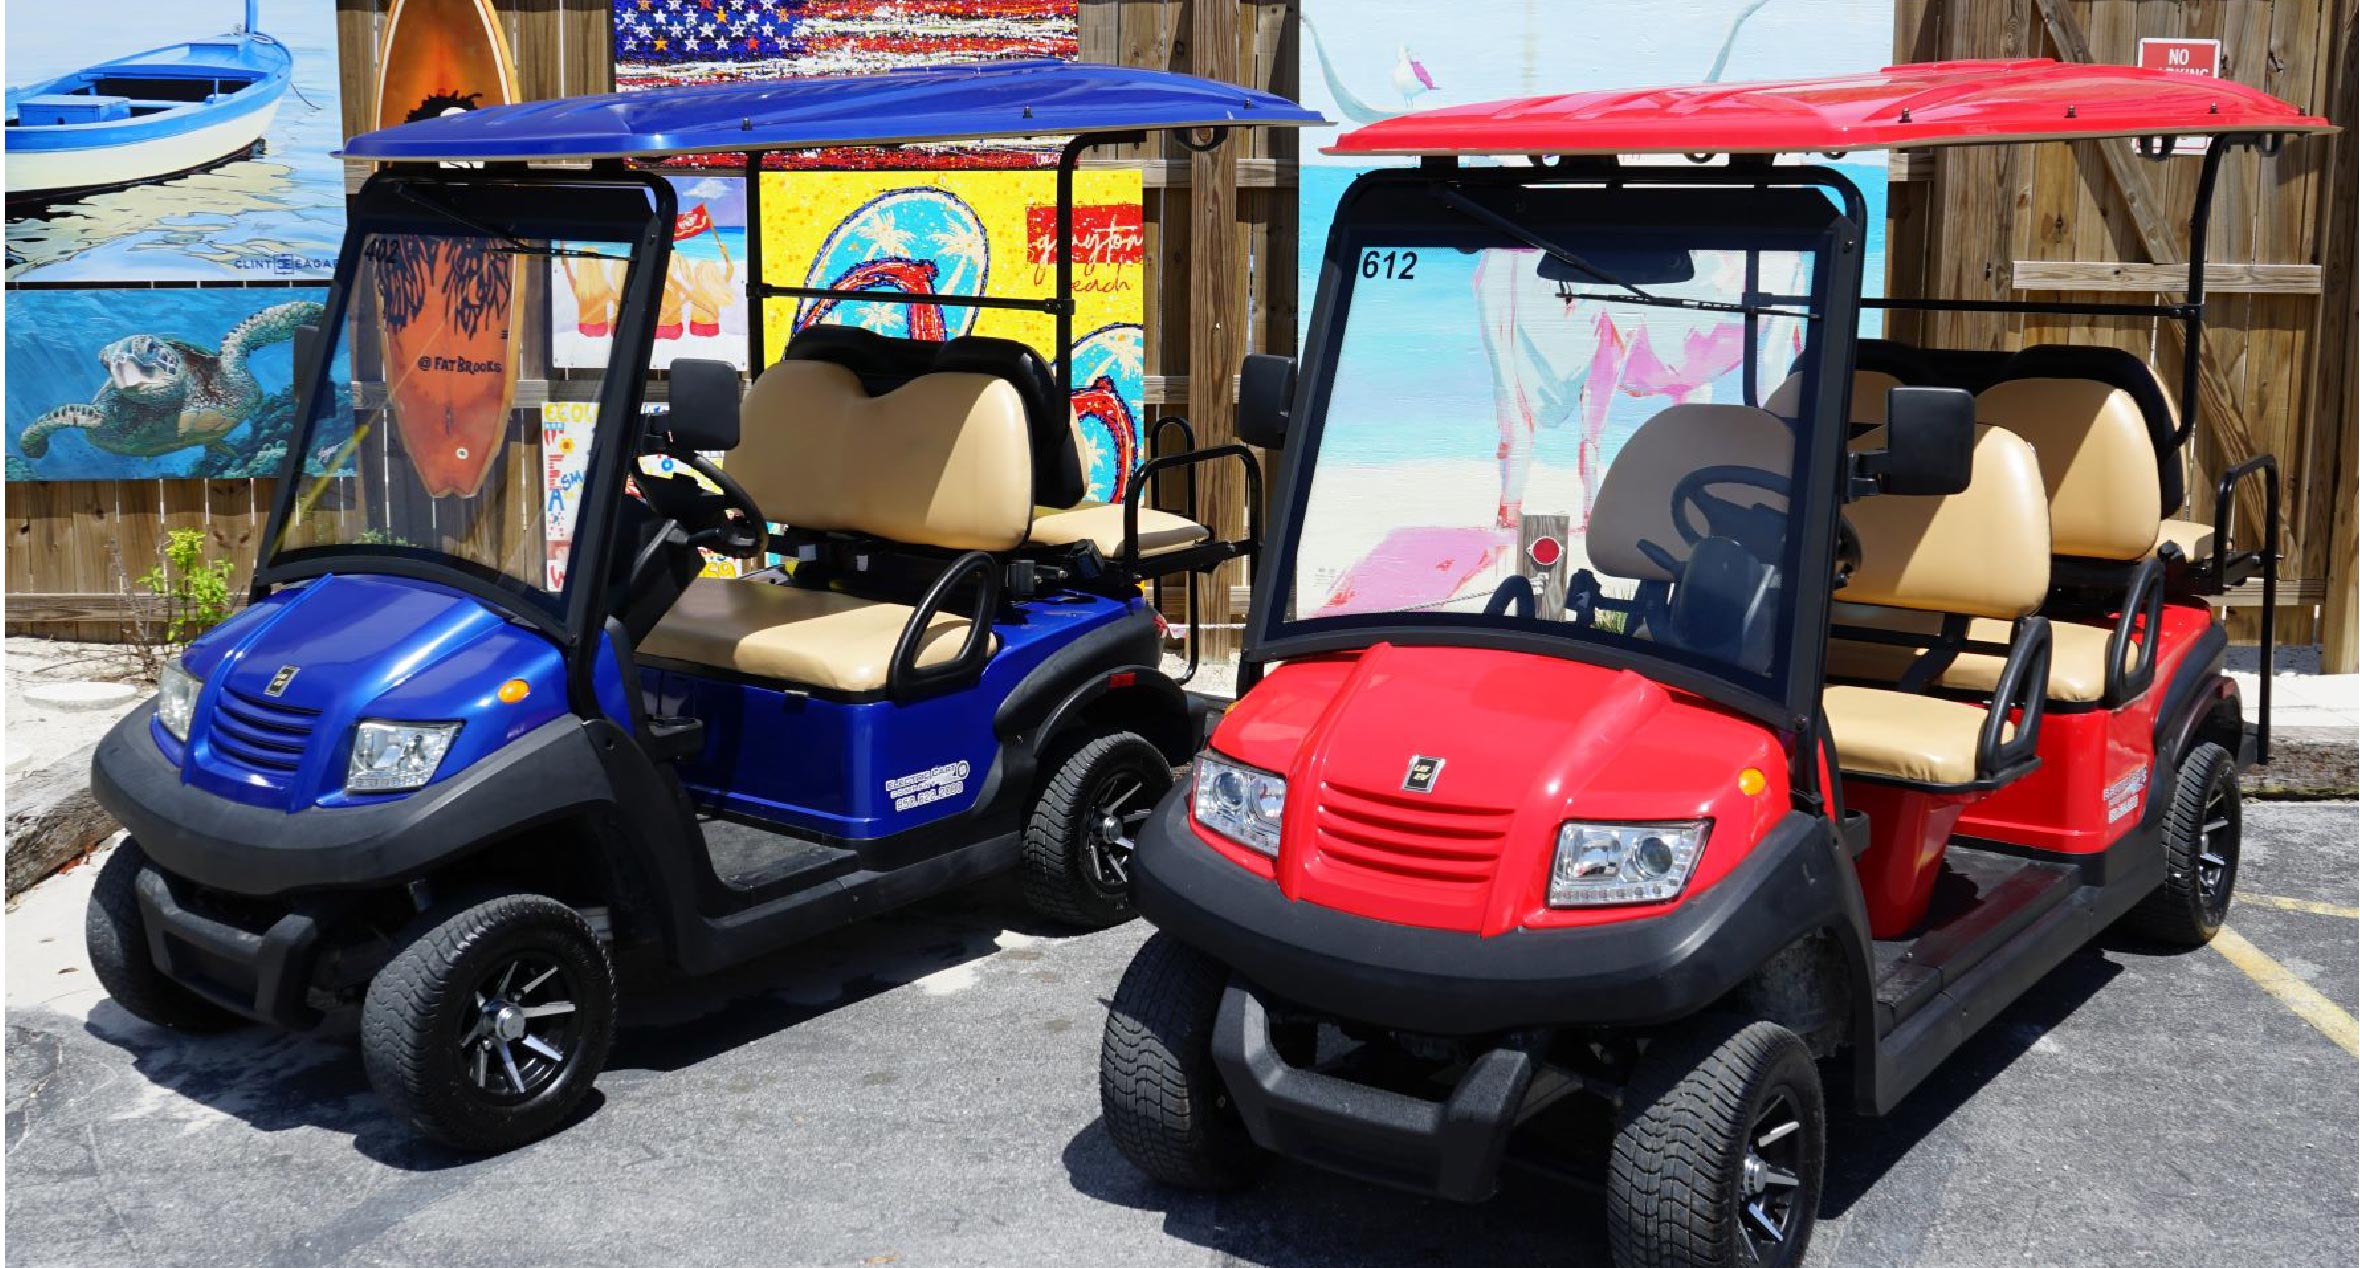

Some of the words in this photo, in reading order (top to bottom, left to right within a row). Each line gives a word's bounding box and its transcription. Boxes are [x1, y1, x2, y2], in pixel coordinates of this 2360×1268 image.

[2168, 48, 2190, 66] NO
[364, 237, 400, 263] 402
[1028, 214, 1143, 287] gyton
[234, 258, 270, 270] CLINT
[1070, 258, 1131, 293] each
[1362, 250, 1418, 280] 612
[544, 402, 600, 423] ECOL
